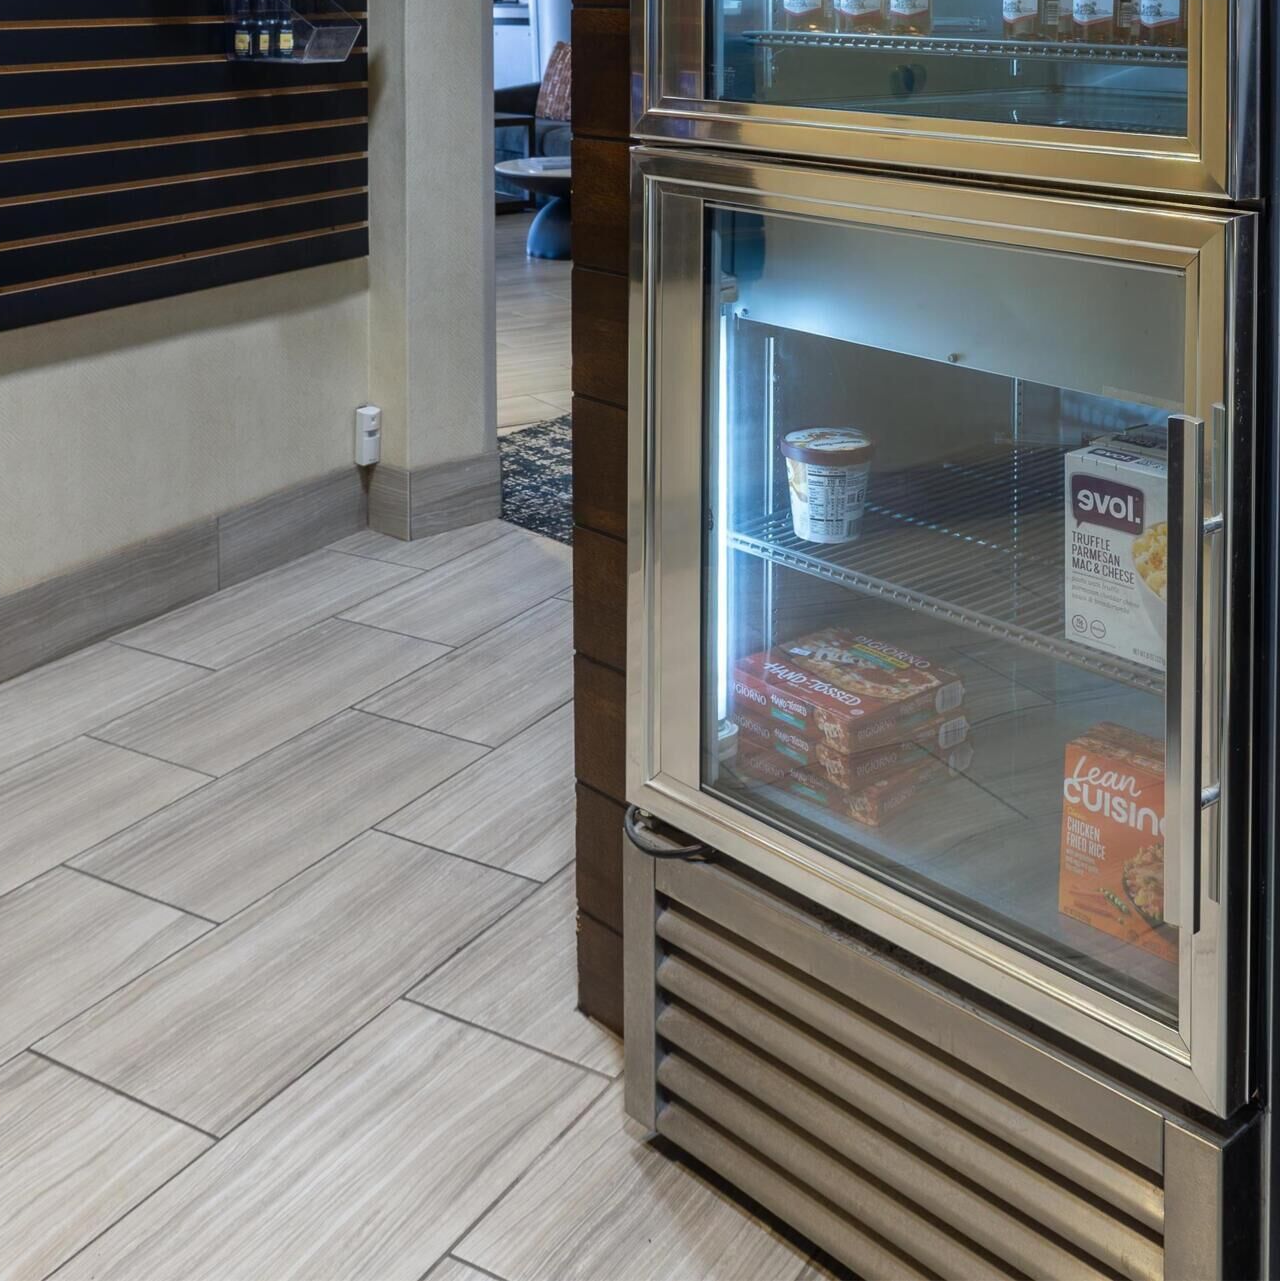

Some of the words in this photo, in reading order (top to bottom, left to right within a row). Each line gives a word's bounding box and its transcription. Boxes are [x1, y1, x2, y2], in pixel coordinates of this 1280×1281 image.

[1077, 488, 1142, 525] evol.
[1071, 530, 1111, 552] TRUFFLE
[1071, 543, 1121, 567] PARMESAN
[1071, 556, 1093, 573] MAC
[1102, 564, 1136, 585] CHEESE
[764, 660, 862, 707] HAND-TOSSED
[1073, 755, 1142, 797] Lean
[1067, 815, 1101, 842] CHICKEN
[1066, 831, 1087, 853] FRIED
[1088, 841, 1107, 861] RICE
